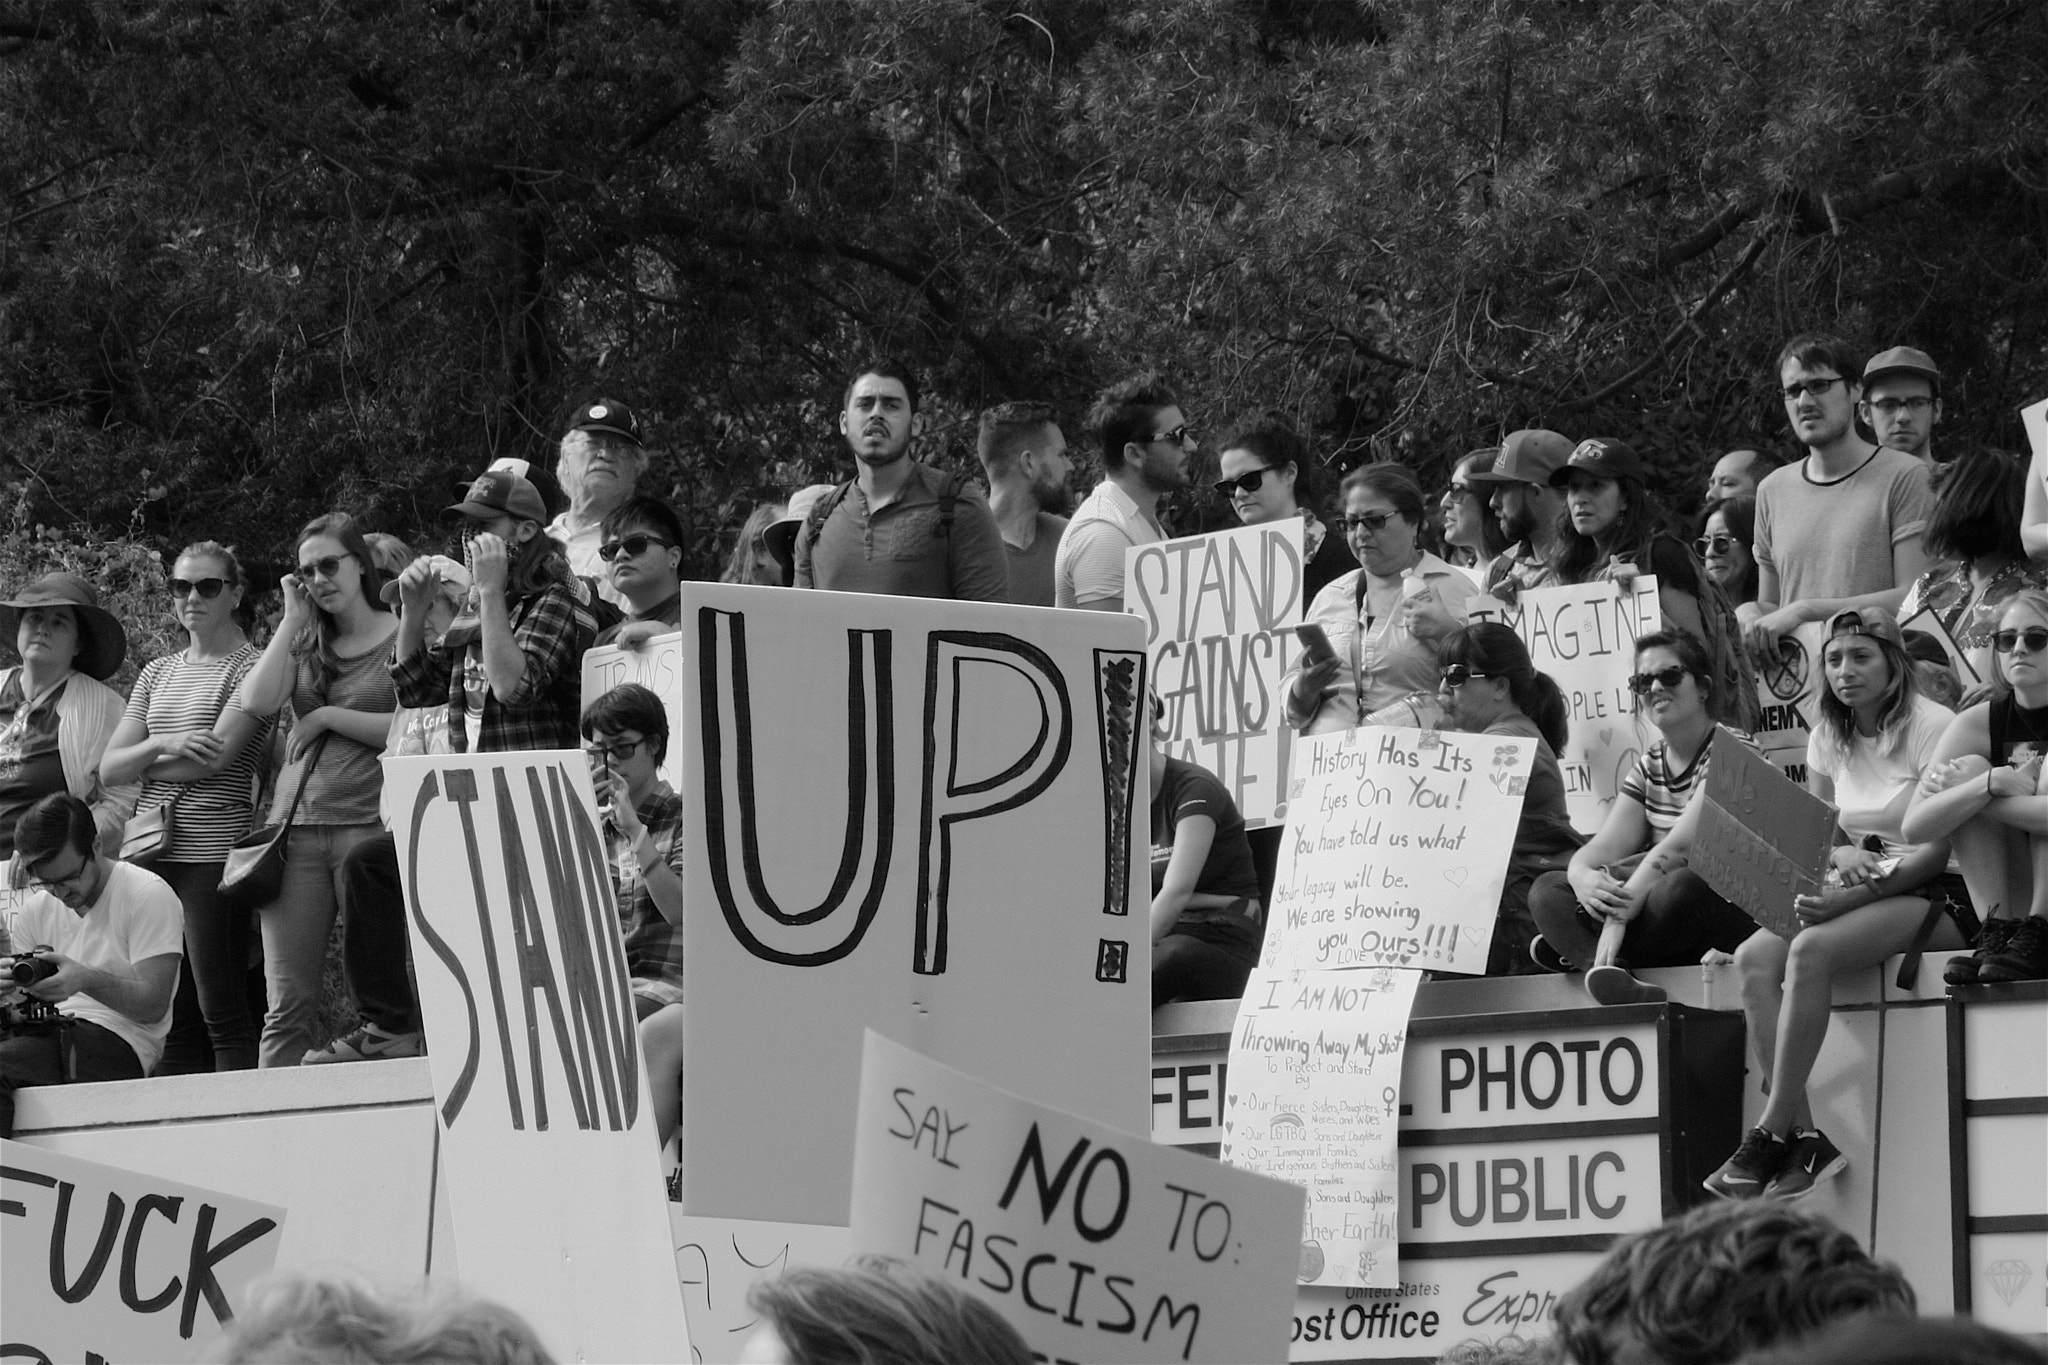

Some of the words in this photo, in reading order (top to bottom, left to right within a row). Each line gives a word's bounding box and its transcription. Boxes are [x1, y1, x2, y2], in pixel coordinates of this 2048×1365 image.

[1134, 529, 1301, 646] STAND
[1151, 626, 1296, 742] GAINST
[1312, 741, 1367, 780] History
[1377, 734, 1419, 768] Has
[1433, 740, 1473, 773] Its
[698, 606, 1147, 983] UP!
[1320, 783, 1348, 822] Eyes
[1357, 779, 1391, 808] On
[1408, 775, 1467, 810] You!
[1566, 765, 1592, 793] IN
[1294, 824, 1314, 855] You
[1318, 825, 1345, 851] have
[1350, 816, 1382, 846] told
[1389, 833, 1409, 848] us
[1418, 824, 1467, 851] what
[1303, 873, 1336, 904] legacy
[1344, 863, 1373, 891] will
[1382, 866, 1409, 889] be.
[1287, 908, 1308, 930] We
[1311, 908, 1335, 924] are
[1345, 894, 1421, 931] showing
[408, 760, 639, 1131] STAND
[1316, 932, 1348, 963] you
[1360, 923, 1460, 964] Ours!!!
[1337, 949, 1367, 965] LOVE
[1258, 980, 1283, 1010] I
[1291, 985, 1326, 1011] AM
[1328, 985, 1377, 1012] NOT
[1241, 1015, 1310, 1064] Throwing
[1313, 1030, 1350, 1064] Away
[1353, 1032, 1376, 1067] My
[1378, 1030, 1404, 1055] Shot
[1264, 1056, 1278, 1074] To
[1285, 1056, 1323, 1074] Protect
[1327, 1062, 1345, 1075] and
[1347, 1060, 1372, 1075] Stand
[1295, 1074, 1311, 1090] By
[1441, 1036, 1643, 1114] PHOTO
[1249, 1092, 1271, 1111] Our
[1273, 1095, 1306, 1113] Fierce
[1246, 1126, 1265, 1140] Our
[1270, 1125, 1306, 1141] LGTBQ
[1248, 1146, 1269, 1160] Our
[888, 1087, 970, 1170] SAY
[998, 1121, 1130, 1243] NO
[1166, 1183, 1243, 1265] TO:
[1266, 1159, 1317, 1176] Indigenous
[1367, 1155, 1396, 1171] Sisters
[1315, 1189, 1336, 1203] Sons
[1337, 1191, 1351, 1203] and
[1354, 1189, 1395, 1211] Daughters
[1412, 1151, 1626, 1229] PUBLIC
[1303, 1212, 1339, 1241] ther
[1343, 1211, 1396, 1241] Earth!
[914, 1197, 1200, 1361] FASCISM
[1345, 1285, 1391, 1299] United
[1395, 1282, 1440, 1297] States
[1290, 1307, 1336, 1343] ost
[1340, 1302, 1440, 1340] Office
